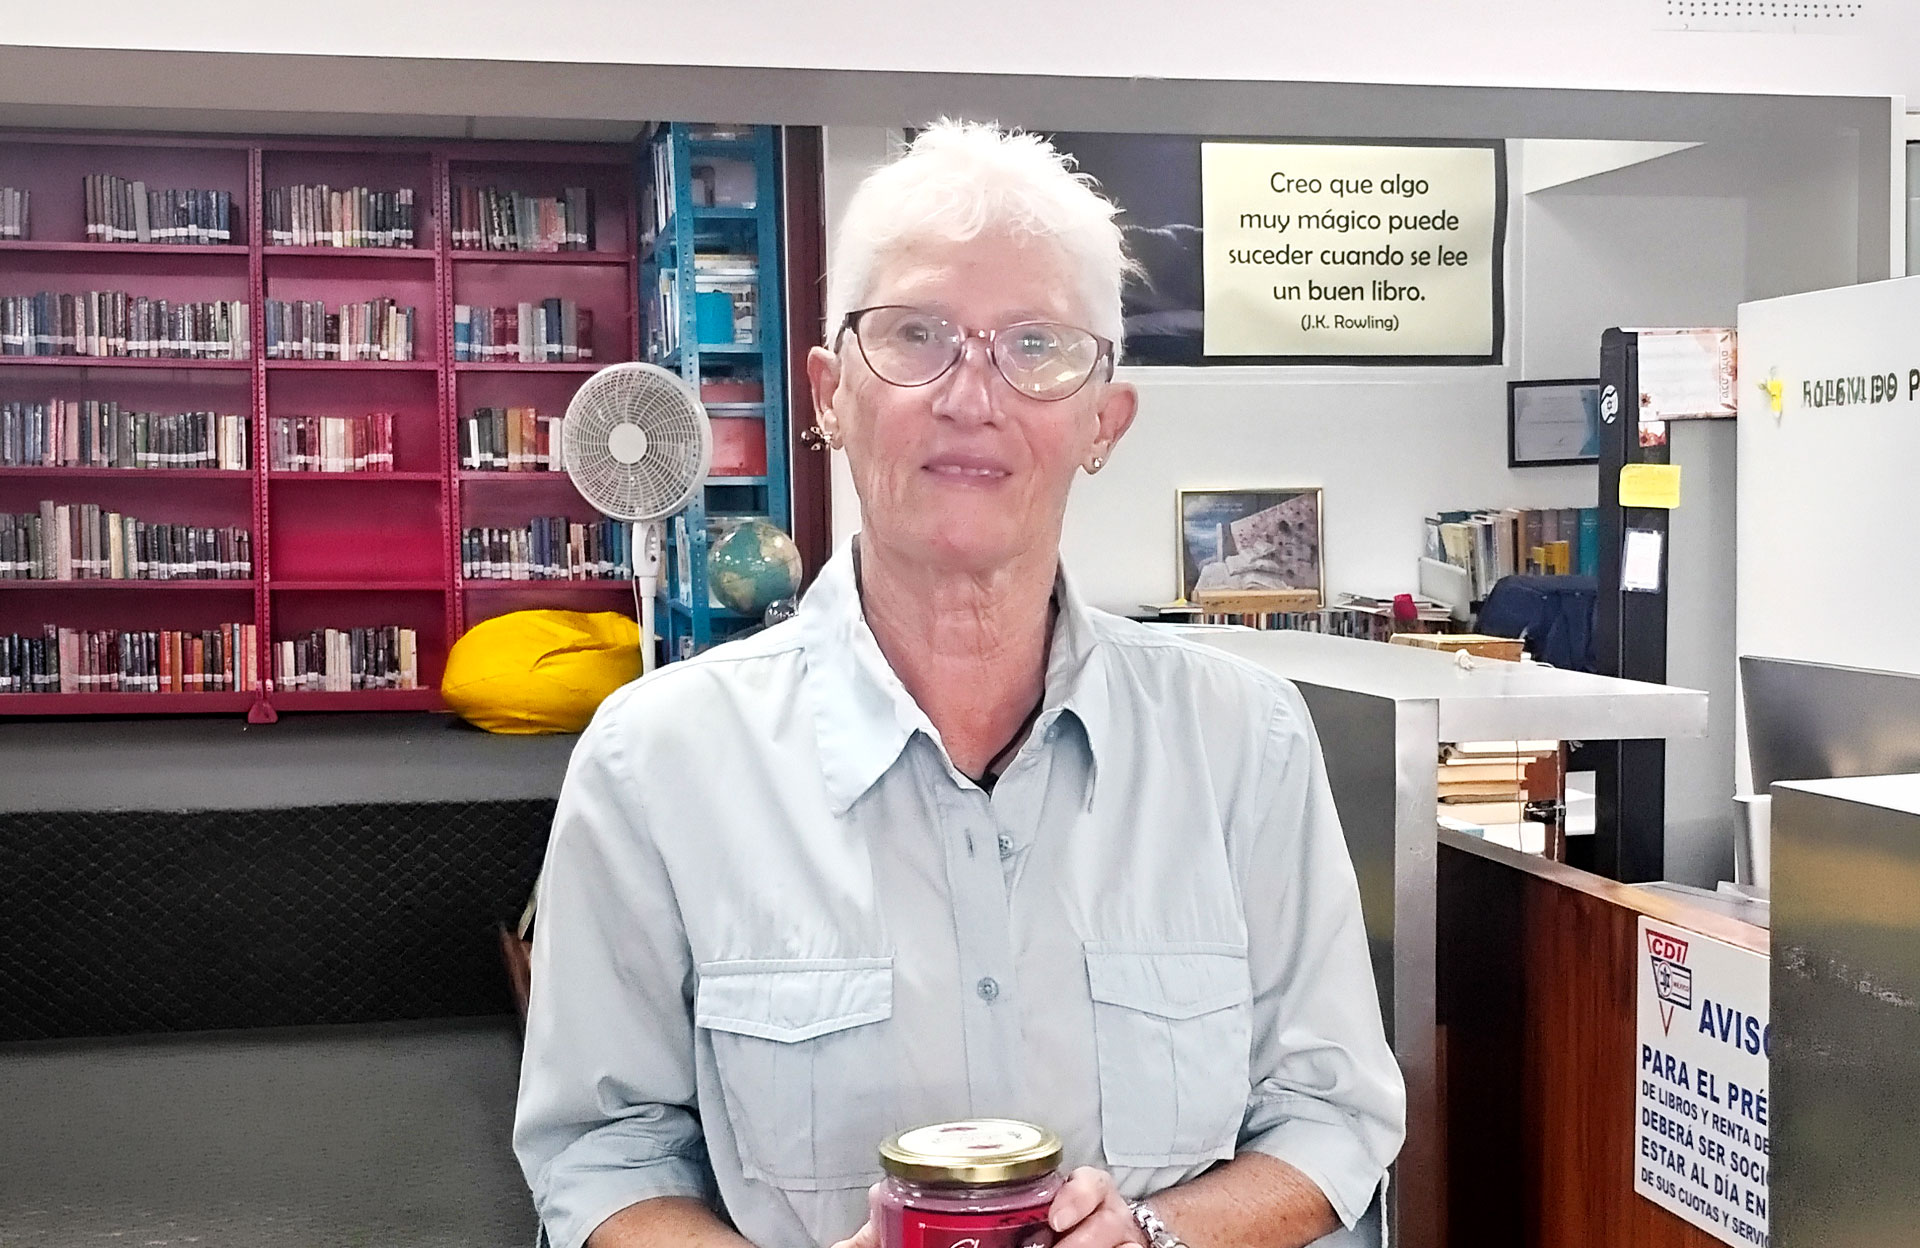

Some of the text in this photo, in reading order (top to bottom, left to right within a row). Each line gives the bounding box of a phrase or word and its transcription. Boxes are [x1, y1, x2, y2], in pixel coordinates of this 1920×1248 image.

[1270, 172, 1429, 198] Creo que algo
[1240, 208, 1459, 234] muy mágico puede
[1228, 243, 1468, 267] suceder cuando se lee
[1273, 279, 1426, 302] un buen libro.
[1300, 314, 1400, 332] (J.K. Rowling)
[1652, 938, 1682, 962] CDI
[1642, 1043, 1767, 1126] PARA EL PRÉ
[1642, 1080, 1656, 1100] DE
[1659, 1087, 1698, 1121] LIBROS
[1701, 1107, 1709, 1125] Y
[1712, 1113, 1751, 1147] RENTA
[1642, 1106, 1768, 1186] DEBERÁ SER SOCI
[1641, 1135, 1766, 1219] ESTAR AL DÍA EN
[1641, 1167, 1654, 1187] DE
[1656, 1175, 1676, 1198] SUS
[1678, 1187, 1719, 1222] CUOTAS
[1722, 1210, 1729, 1227] Y
